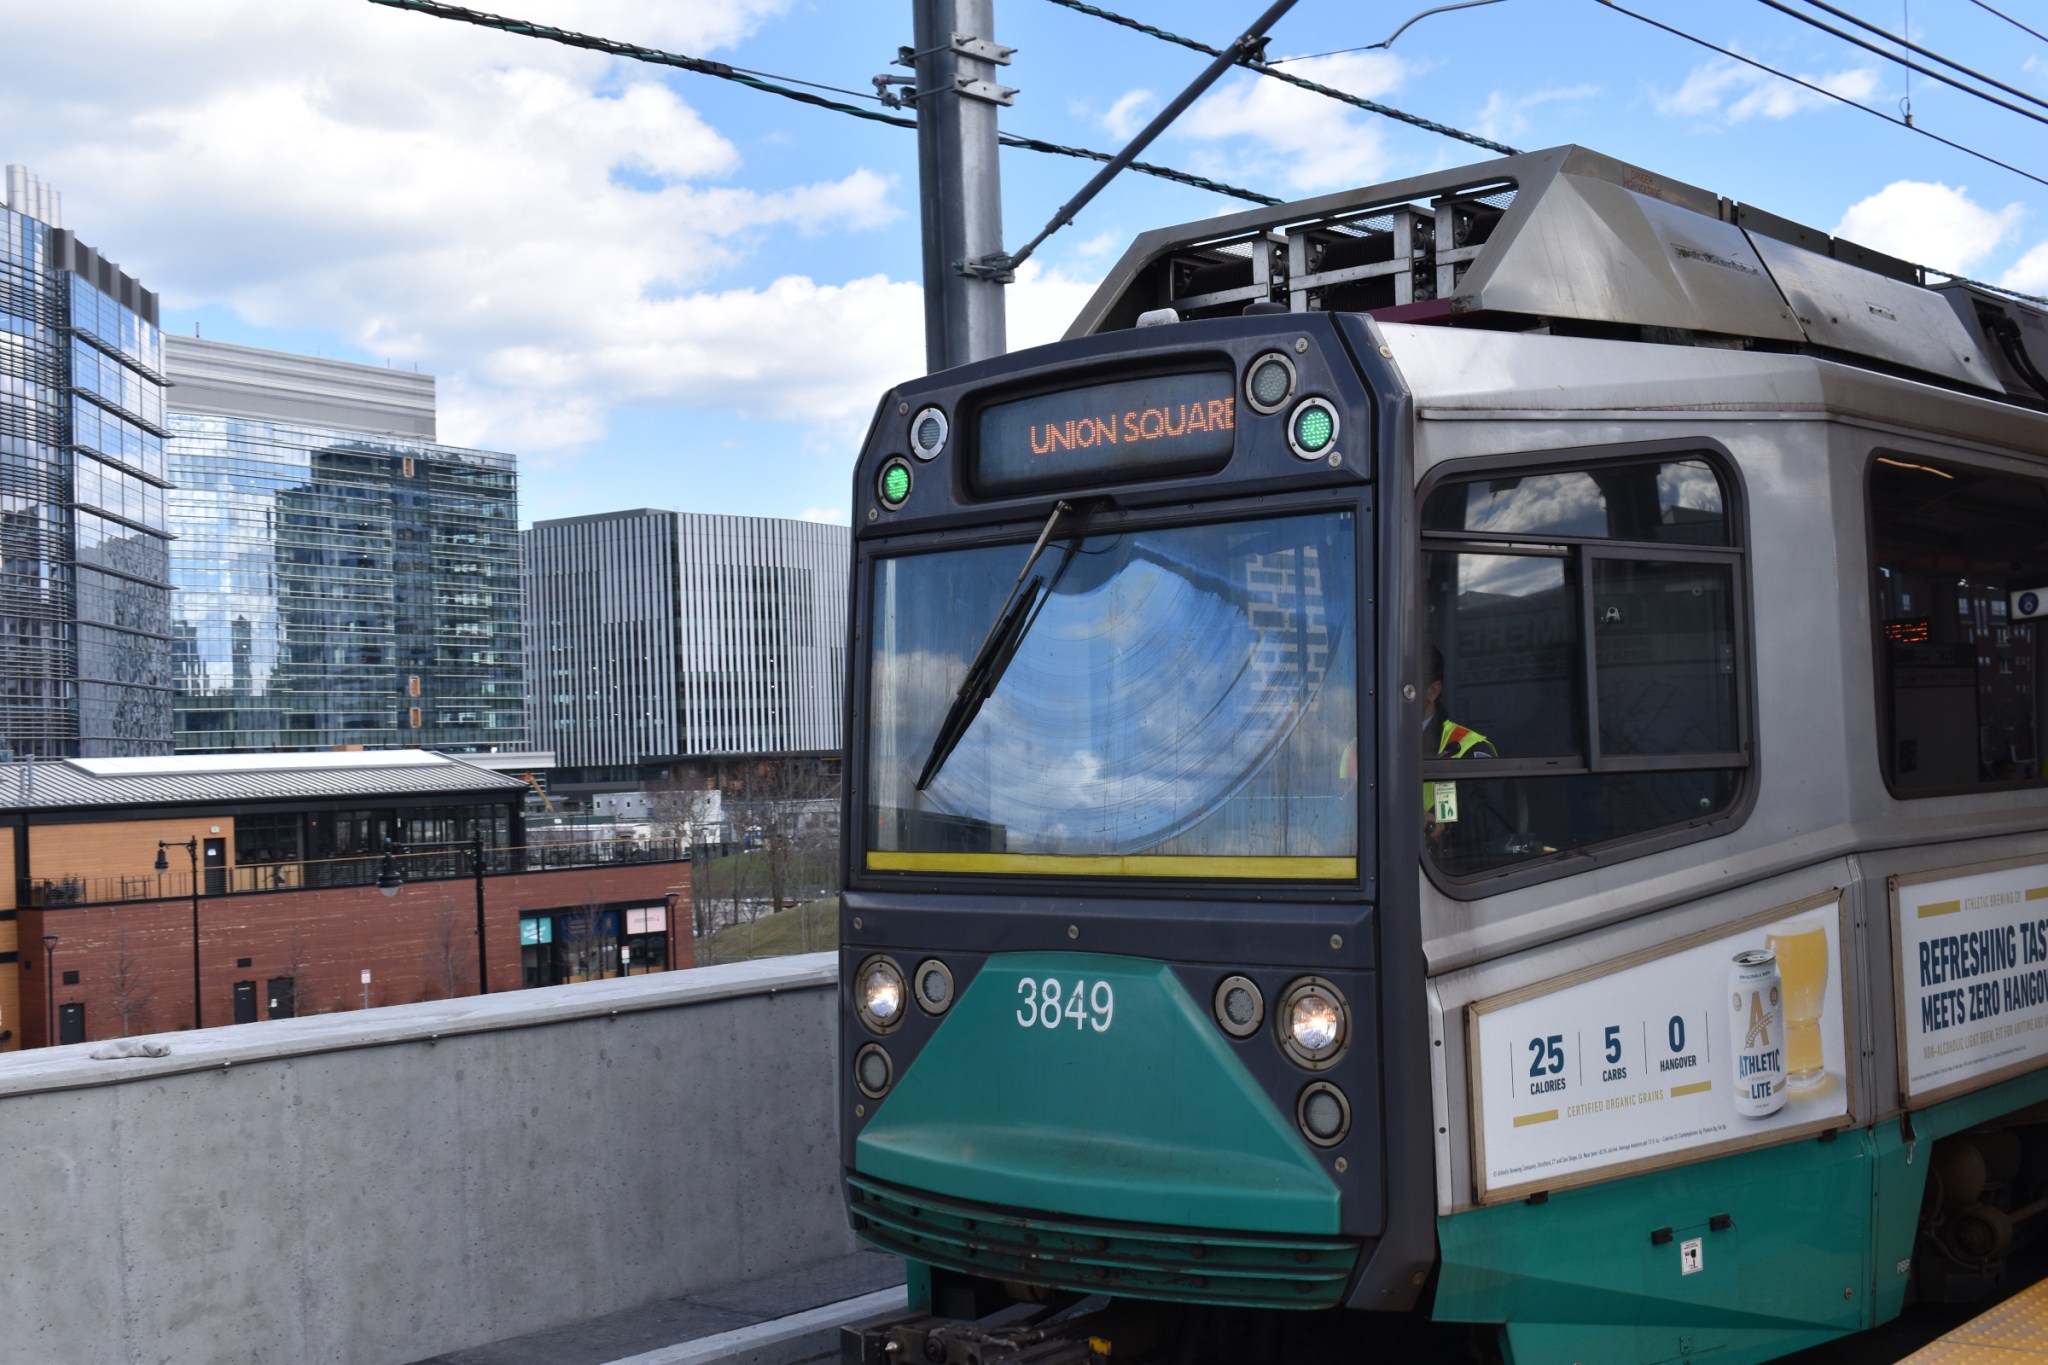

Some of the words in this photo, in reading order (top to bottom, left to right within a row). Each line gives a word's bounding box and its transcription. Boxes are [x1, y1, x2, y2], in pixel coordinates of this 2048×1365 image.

[1031, 415, 1117, 454] UNION
[1124, 397, 1235, 442] SQUARE
[1919, 925, 2016, 987] REFRESHING
[2020, 918, 2048, 964] TAS
[1017, 977, 1114, 1032] 3849
[1921, 988, 1965, 1034] MEETS
[1969, 980, 2000, 1021] ZERO
[1605, 1025, 1622, 1064] 5
[1668, 1015, 1685, 1052] 0
[1529, 1034, 1565, 1077] 25
[1660, 1055, 1697, 1072] HANGOVER
[1739, 1048, 1780, 1080] ATHLETIC
[1530, 1078, 1566, 1095] CALORIES
[1602, 1067, 1627, 1082] CARBS
[1751, 1081, 1772, 1099] LITE
[1567, 1101, 1604, 1118] CERTIFIED
[1606, 1094, 1636, 1110] ORGANIC
[1638, 1090, 1664, 1105] GRAINS
